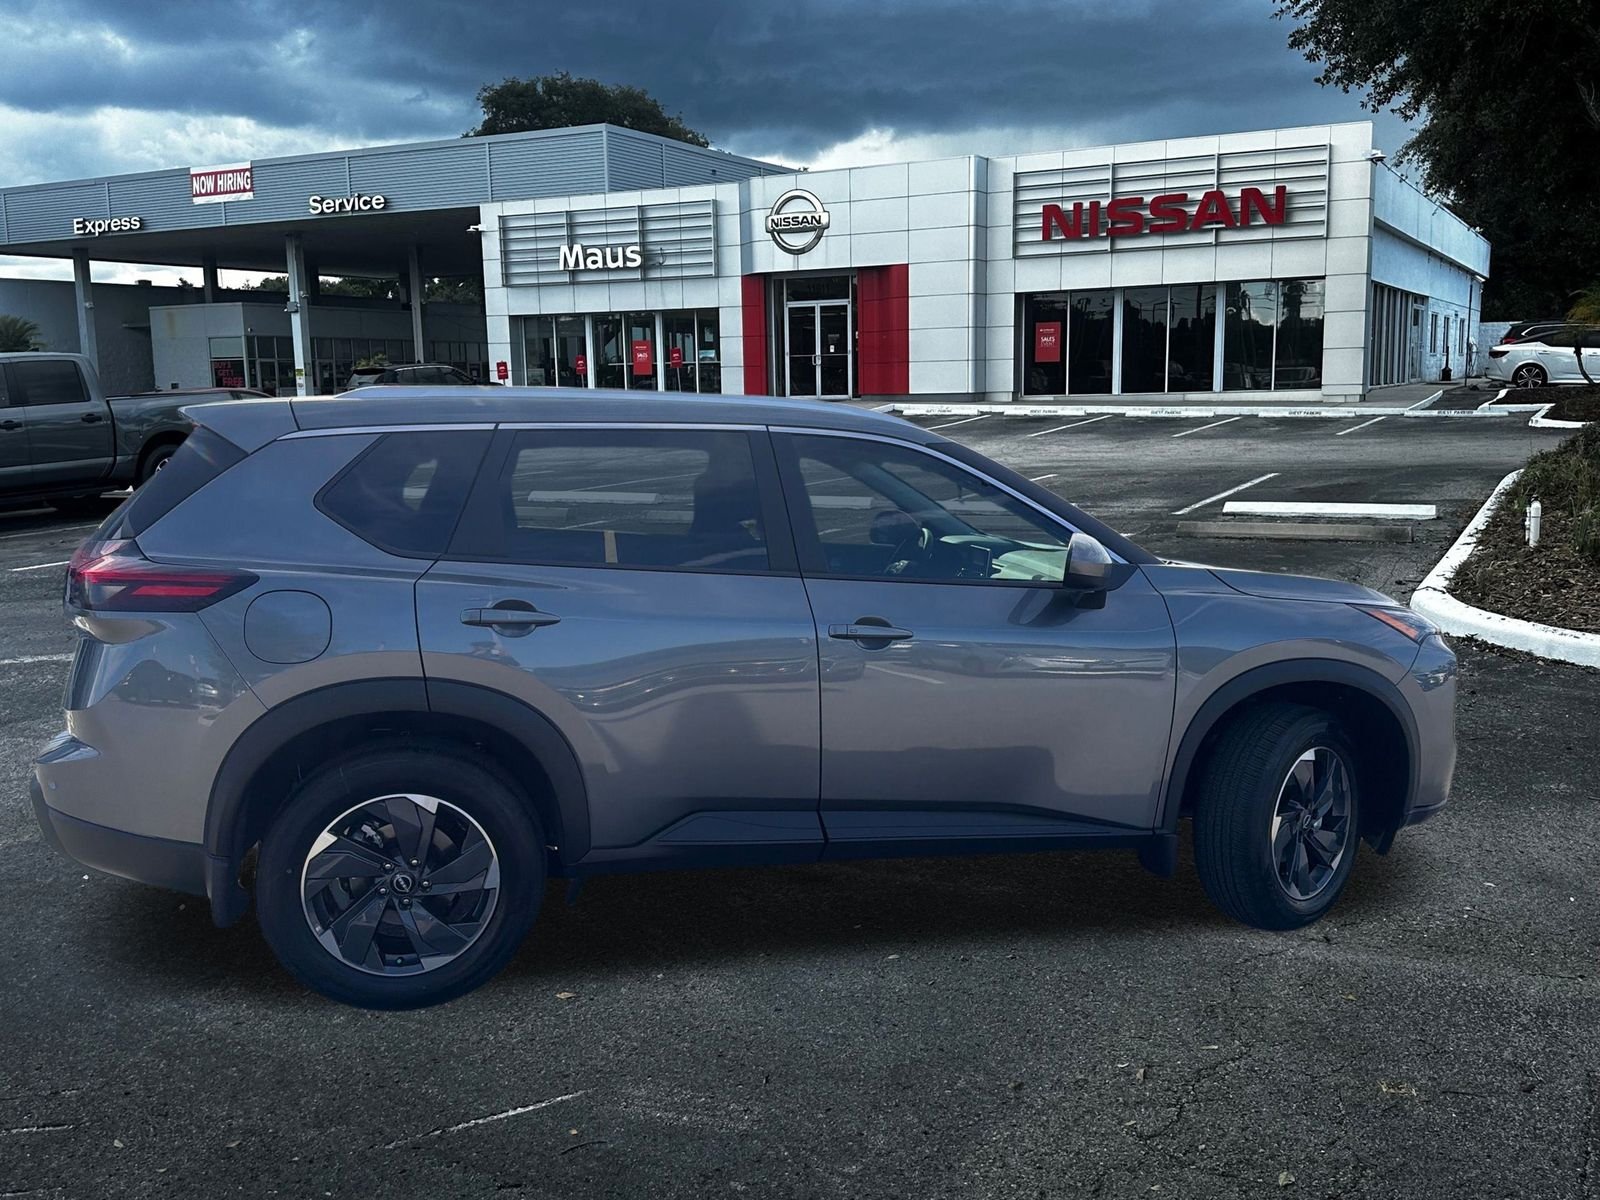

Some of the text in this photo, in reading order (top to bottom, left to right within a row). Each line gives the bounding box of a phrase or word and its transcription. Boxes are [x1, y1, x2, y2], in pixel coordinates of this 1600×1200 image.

[193, 171, 251, 195] NOW HIRING
[309, 193, 385, 214] Service
[1042, 185, 1286, 241] NISSAN
[73, 216, 141, 236] Express
[770, 214, 822, 228] NISSAN
[560, 243, 642, 271] Maus
